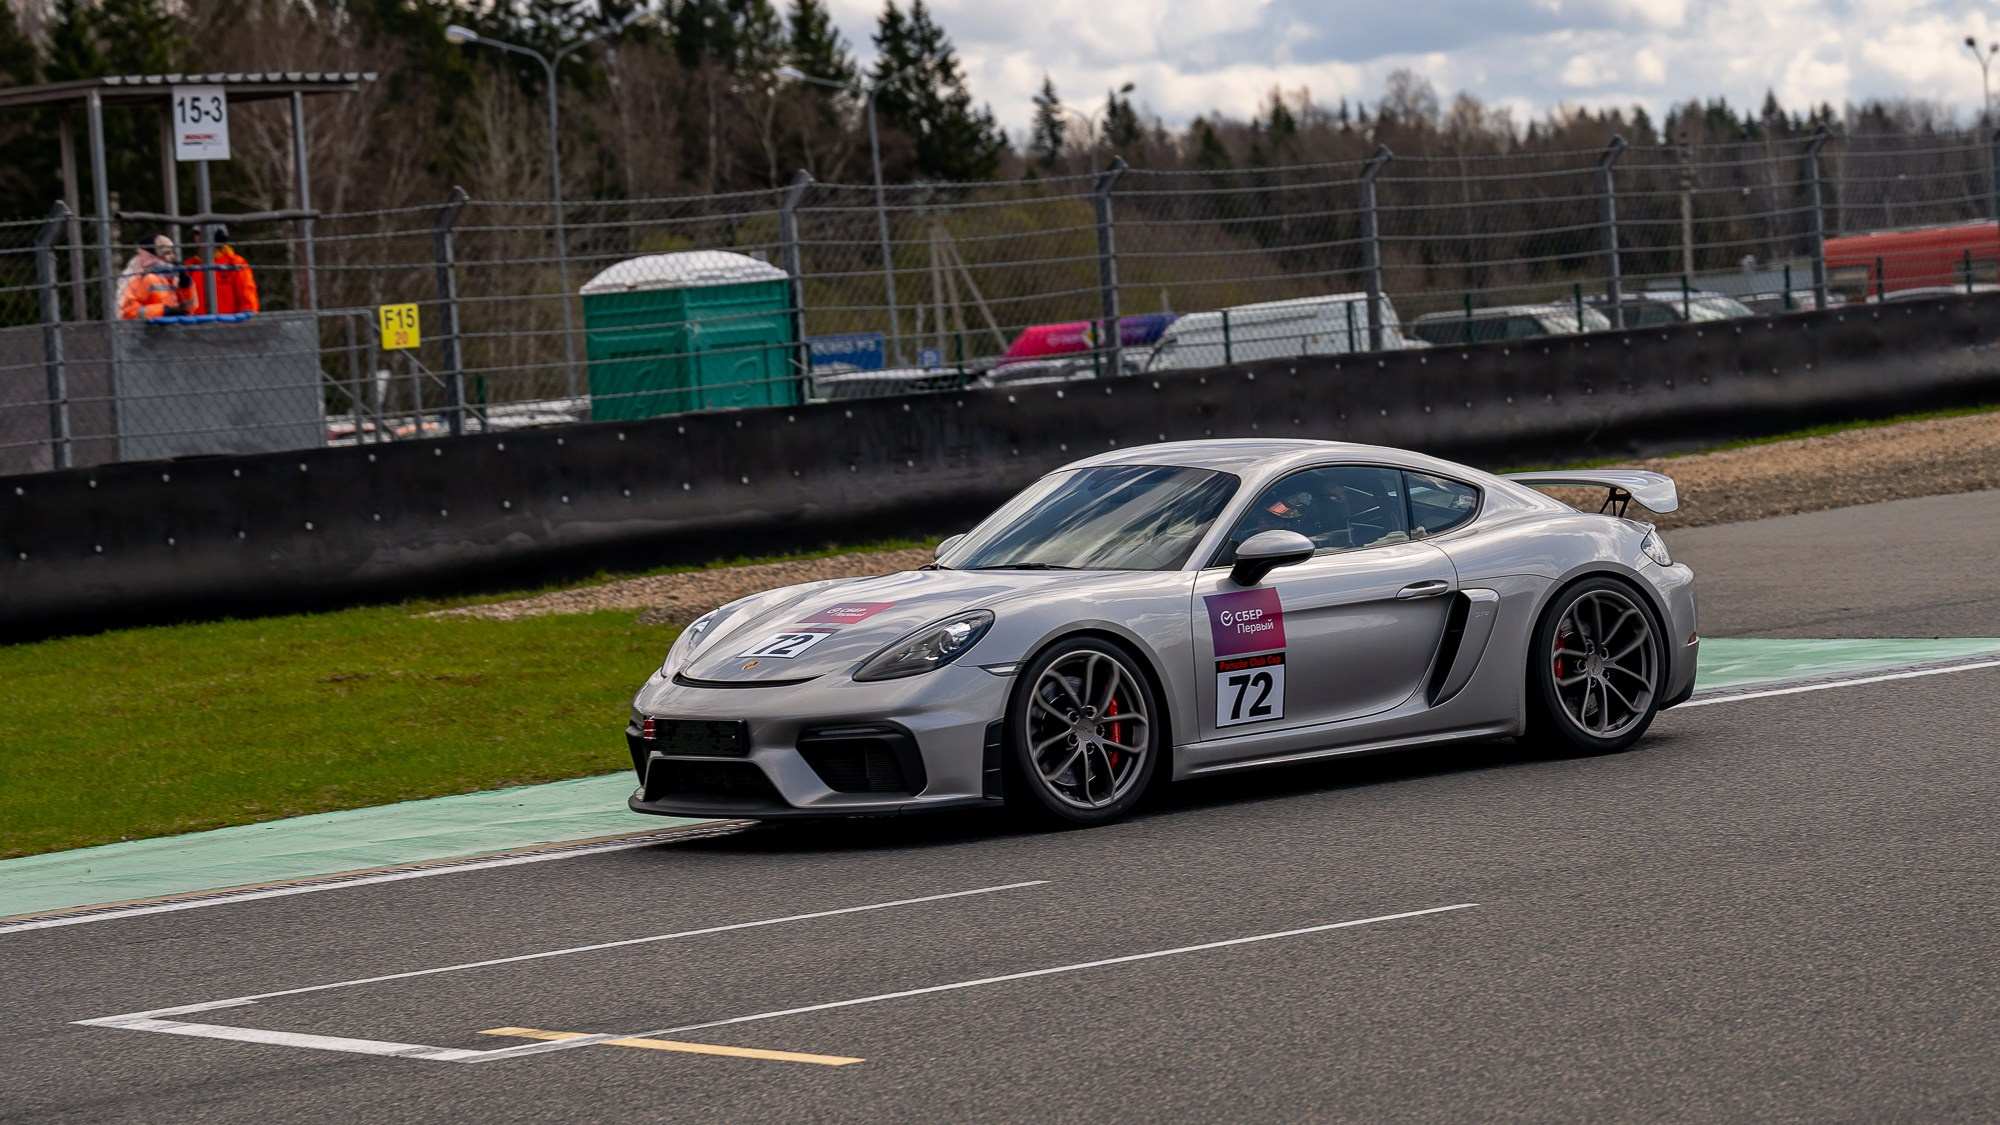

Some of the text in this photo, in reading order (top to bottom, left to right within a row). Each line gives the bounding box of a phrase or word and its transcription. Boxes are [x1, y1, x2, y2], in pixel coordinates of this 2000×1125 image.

[177, 96, 223, 124] 15-3
[384, 308, 415, 330] F15
[1235, 609, 1263, 622] СБЕР
[1237, 619, 1274, 635] Первый
[752, 634, 815, 655] 72
[1219, 655, 1281, 671] Porsche Club Cup
[1228, 671, 1274, 721] 72
